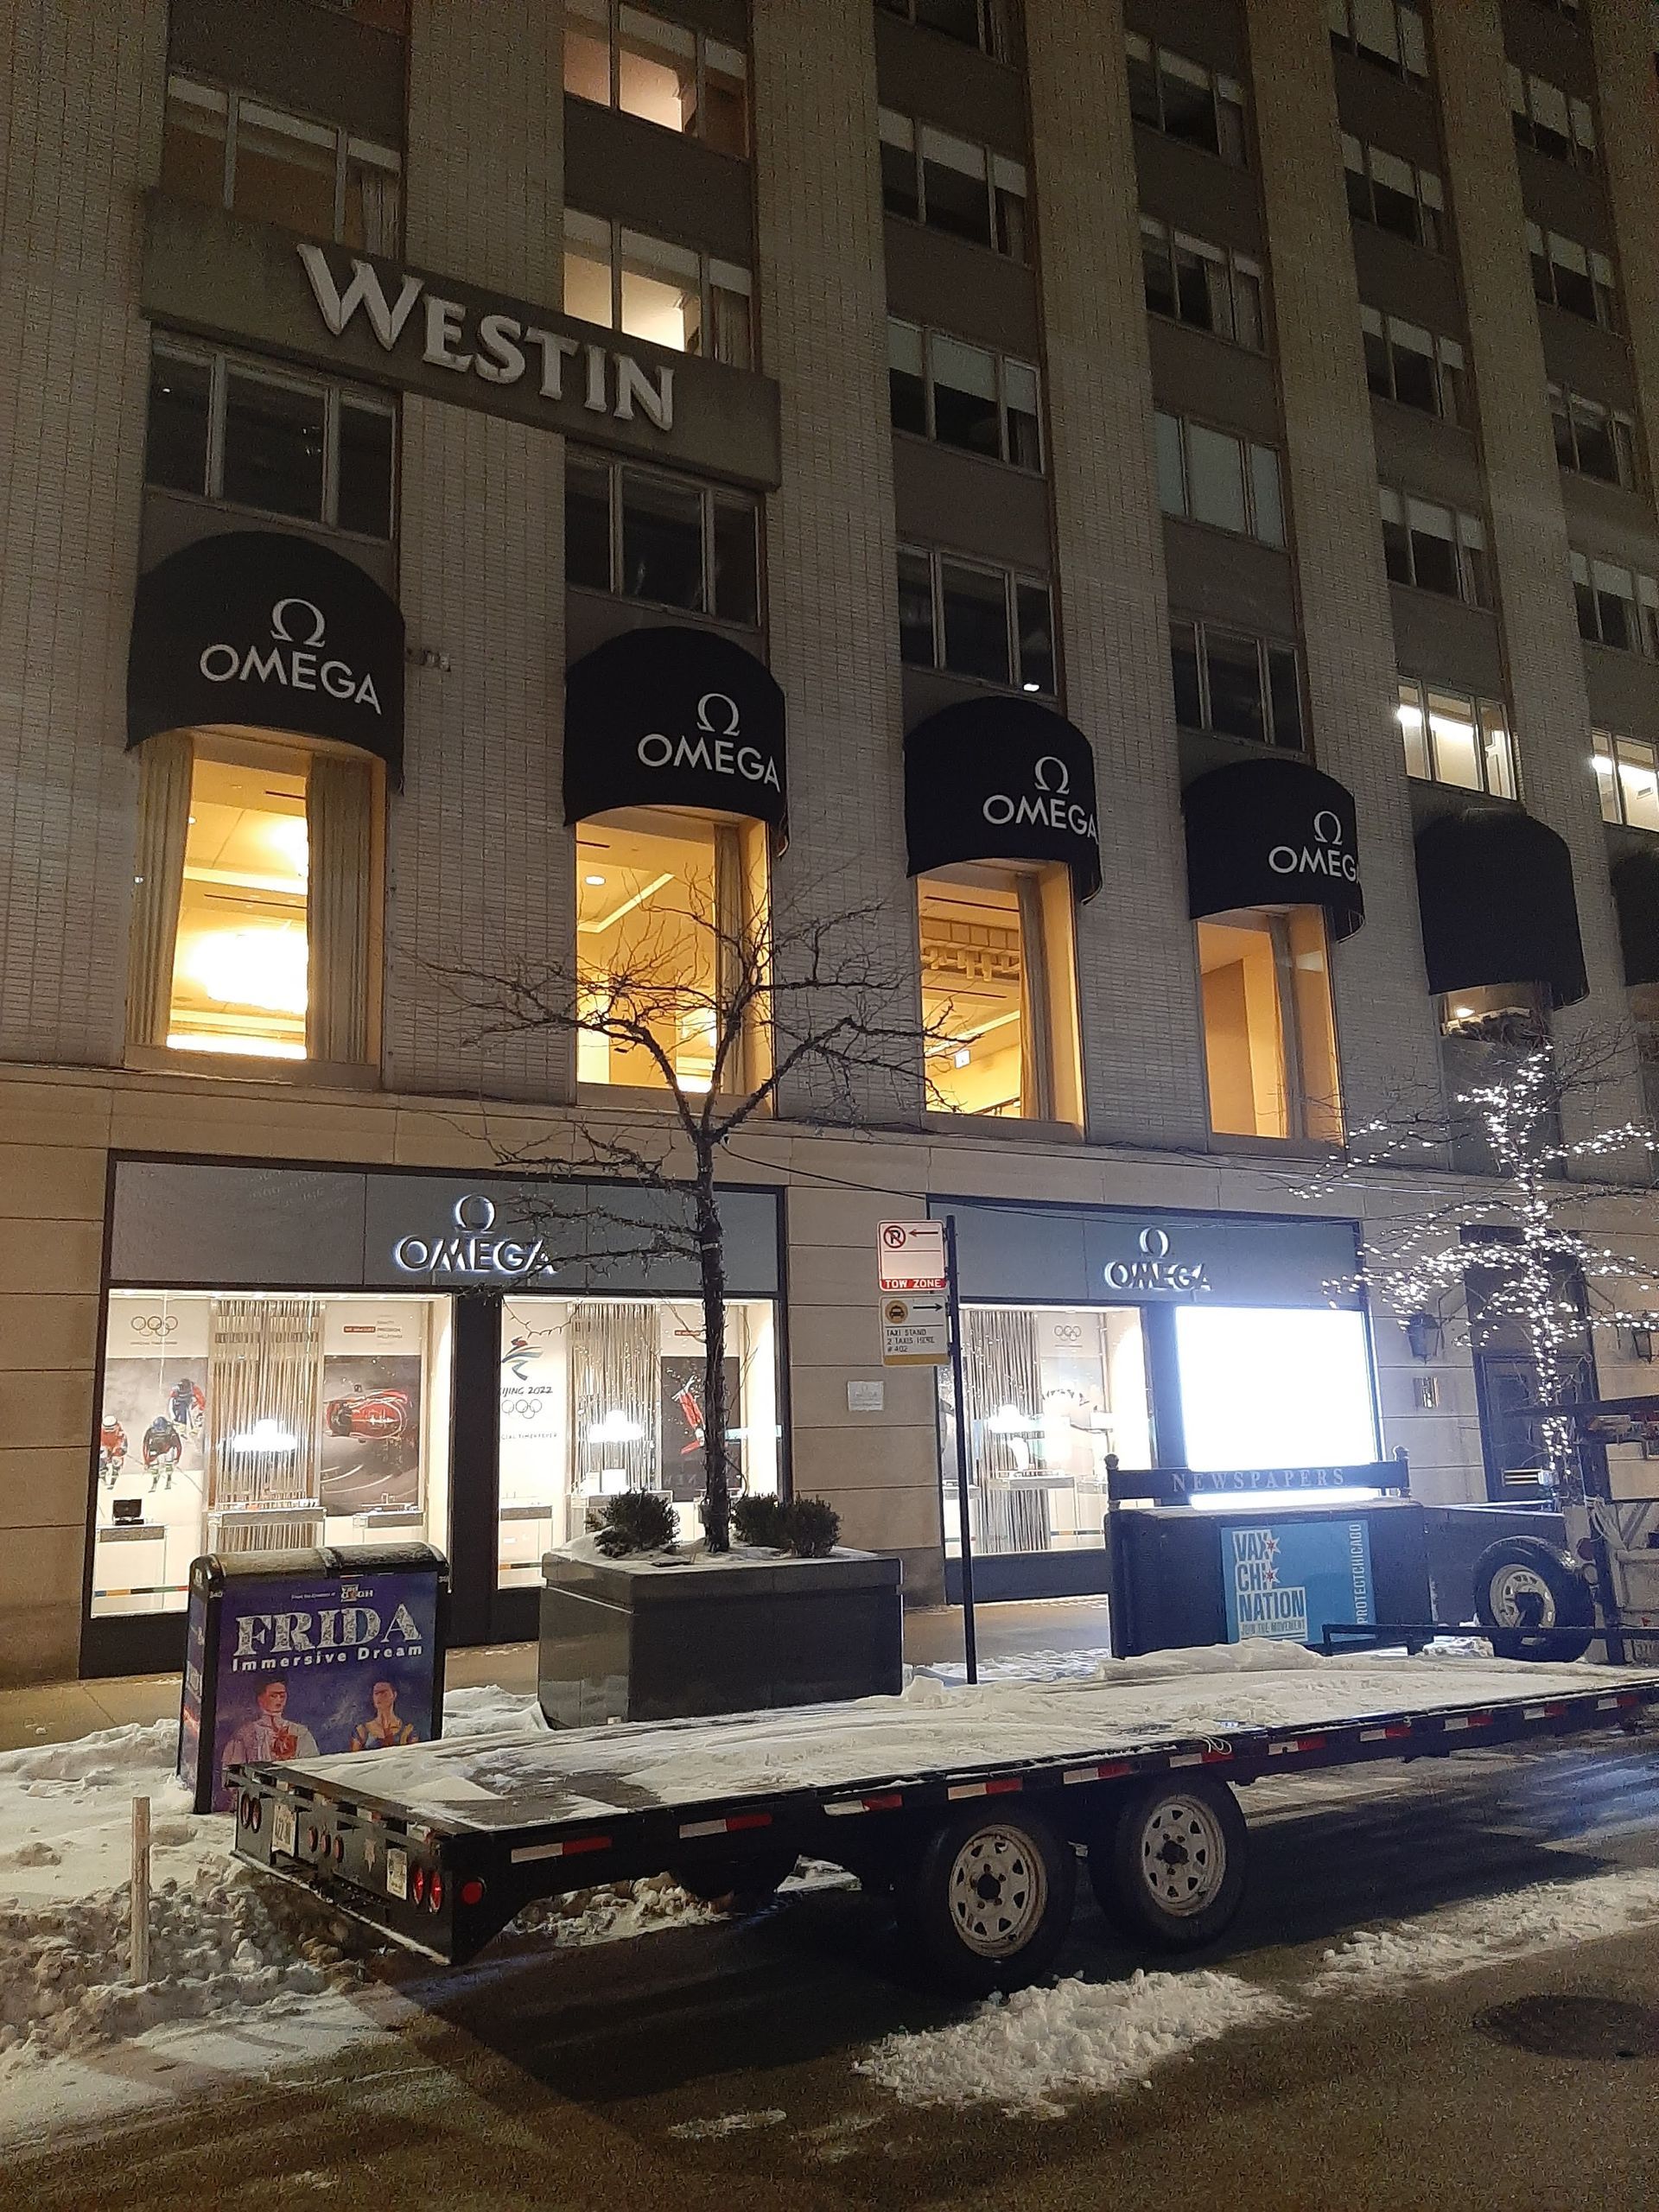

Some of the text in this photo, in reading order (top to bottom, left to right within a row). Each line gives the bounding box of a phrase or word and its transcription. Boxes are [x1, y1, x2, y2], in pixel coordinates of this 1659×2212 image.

[296, 243, 675, 431] WESTIN
[200, 643, 382, 715] OMEGA
[637, 733, 780, 793] OMEGA
[982, 794, 1100, 845] OMEGA
[1268, 846, 1357, 882] OMEG
[395, 1235, 559, 1275] OMEGA
[885, 1278, 942, 1289] TOW ZONE
[1103, 1260, 1213, 1292] OMEGA
[905, 1328, 927, 1337] STAND
[500, 1386, 553, 1397] IJING 2022
[1172, 1468, 1345, 1492] NEWSPAPERS
[1238, 1589, 1305, 1623] NATION
[232, 1603, 423, 1656] FRIDA
[232, 1645, 423, 1672] Immersive Dream
